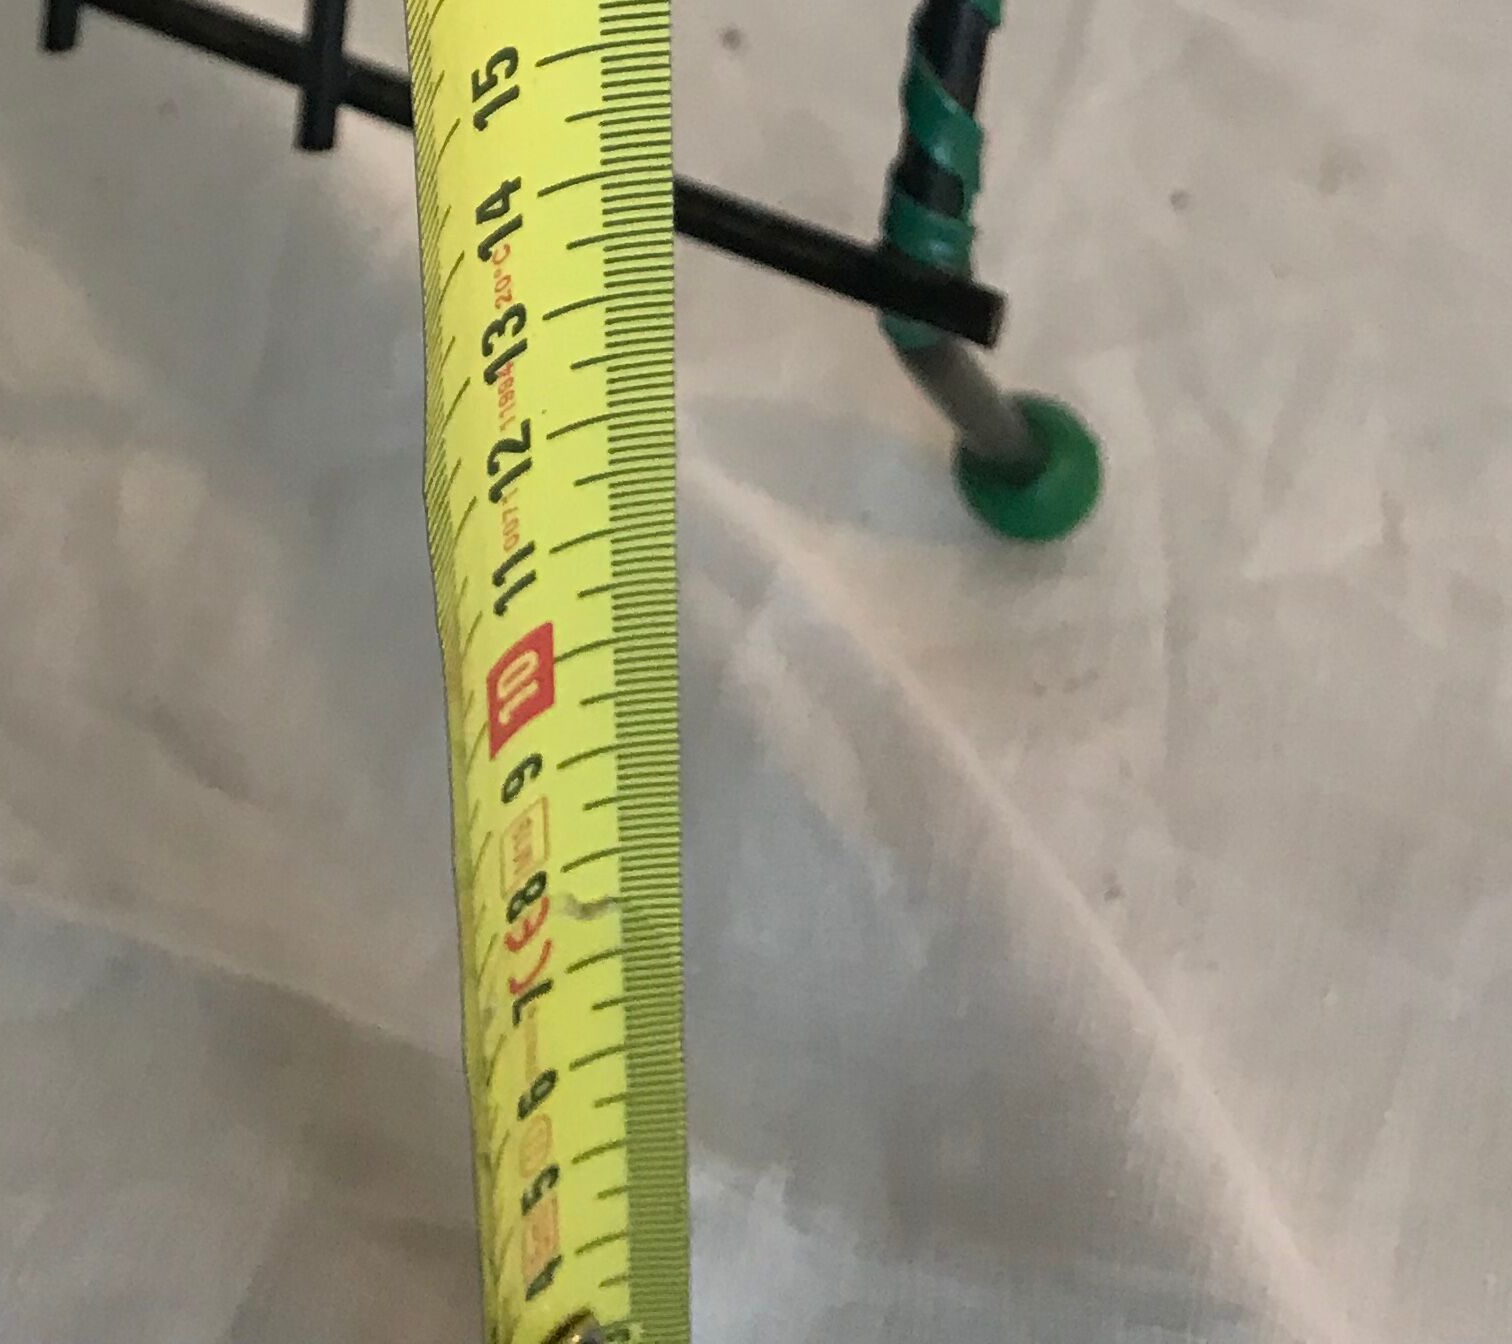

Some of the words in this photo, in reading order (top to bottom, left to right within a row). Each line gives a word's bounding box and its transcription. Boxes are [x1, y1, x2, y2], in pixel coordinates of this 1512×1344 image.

[471, 46, 520, 131] 15
[475, 176, 523, 261] 14
[482, 303, 528, 386] 13
[487, 418, 533, 503] 12
[492, 540, 537, 616] 11
[496, 648, 539, 725] 10
[501, 752, 543, 804] 9
[506, 870, 548, 924] 8
[512, 978, 554, 1027] 7
[517, 1068, 558, 1121] 6
[521, 1163, 561, 1217] 5
